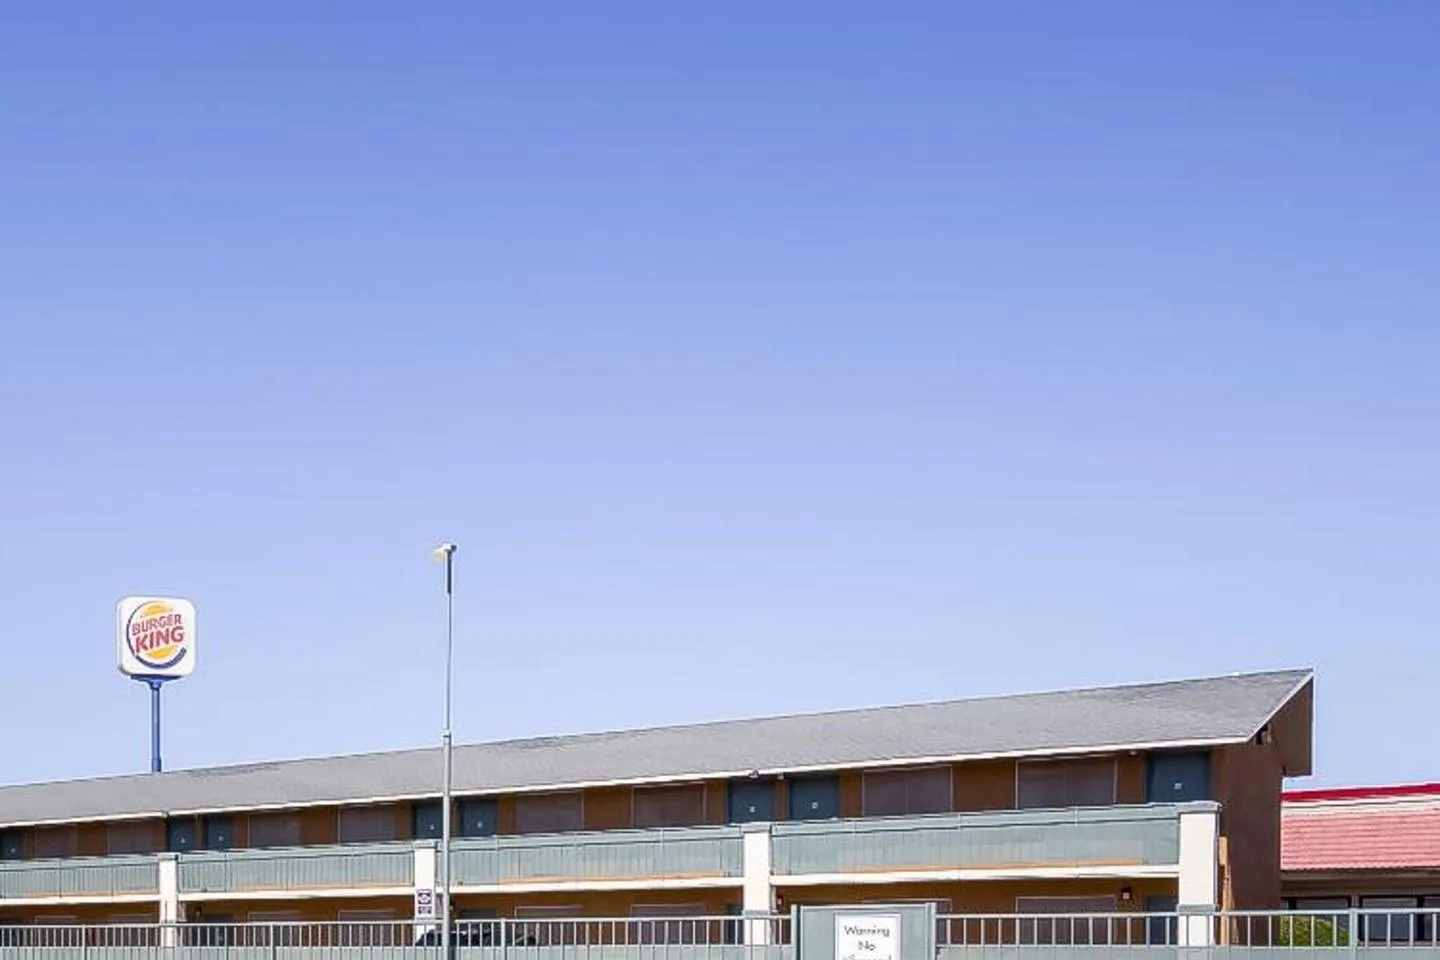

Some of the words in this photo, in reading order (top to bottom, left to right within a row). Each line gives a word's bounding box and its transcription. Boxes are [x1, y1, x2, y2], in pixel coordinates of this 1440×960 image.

[131, 613, 182, 636] BURGER
[135, 626, 184, 653] KING
[844, 925, 890, 937] Warning
[858, 940, 876, 951] No
